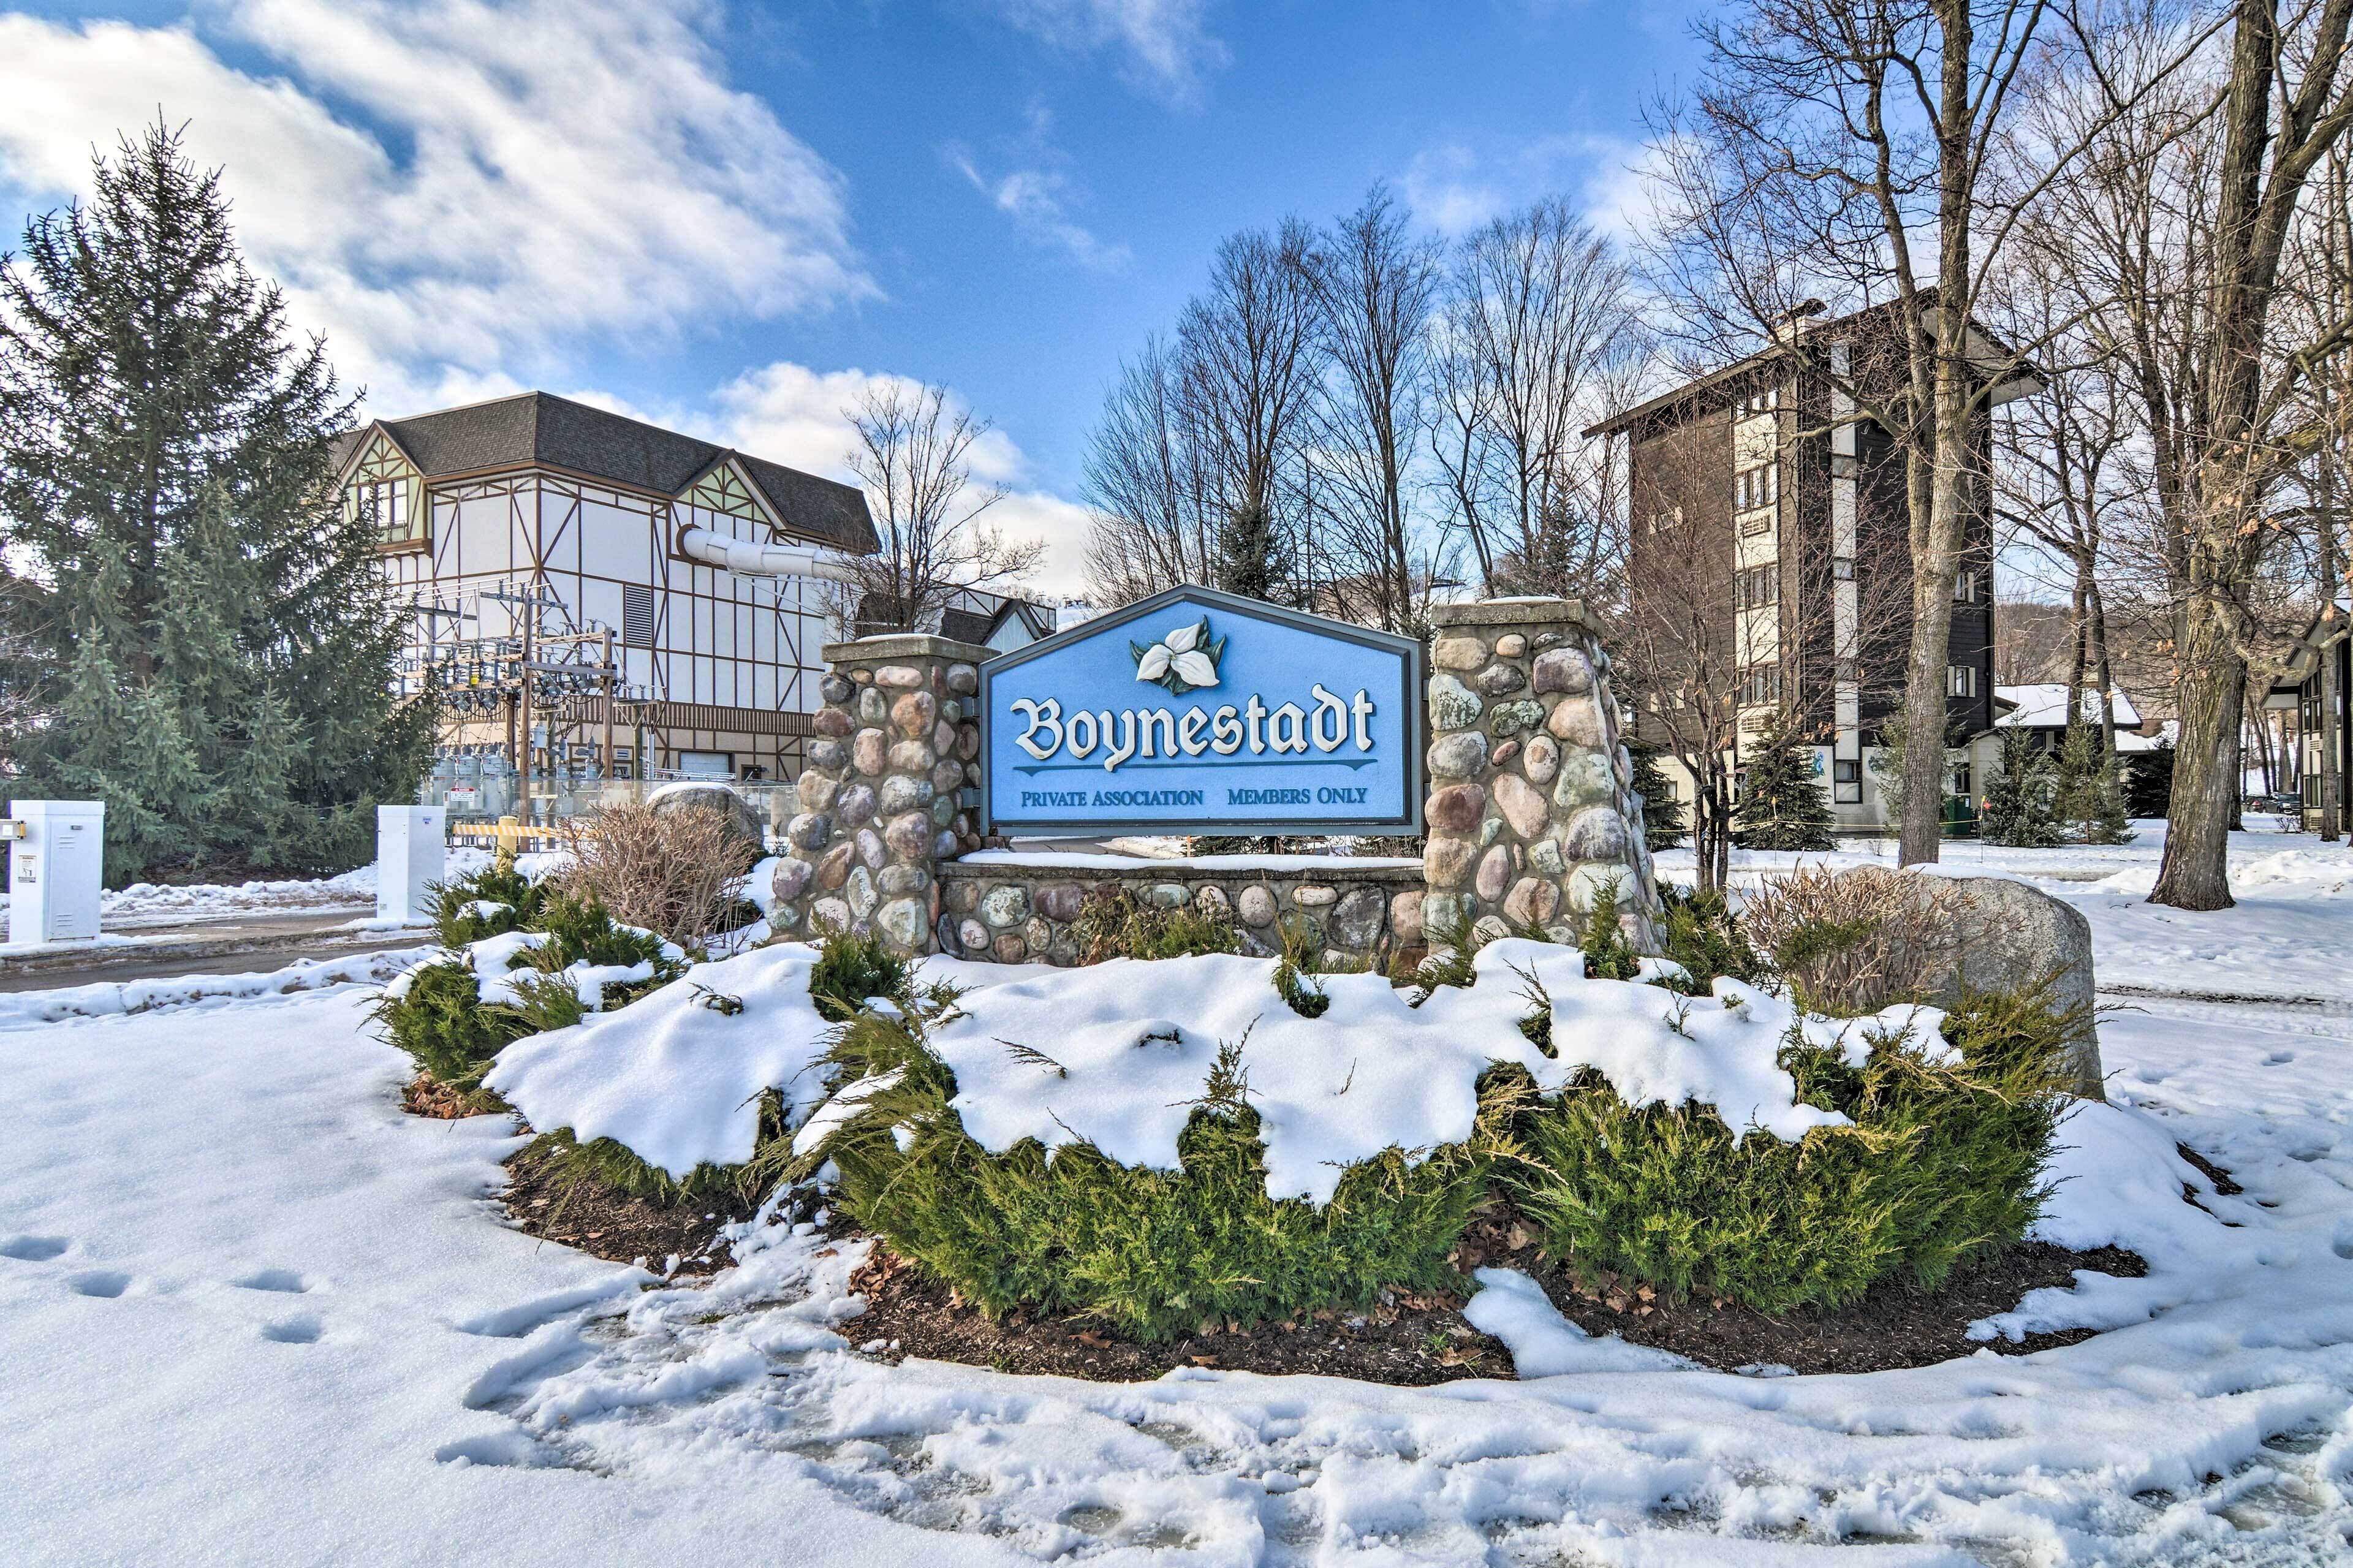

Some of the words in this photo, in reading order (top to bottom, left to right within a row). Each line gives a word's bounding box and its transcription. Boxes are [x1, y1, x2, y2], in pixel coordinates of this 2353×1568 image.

[1010, 683, 1373, 772] Boynestadt
[1021, 791, 1086, 808] PRIVATE
[1091, 790, 1203, 806] ASSOCIATION
[1227, 788, 1310, 805] MEMBERS
[1317, 787, 1368, 804] ONLY
